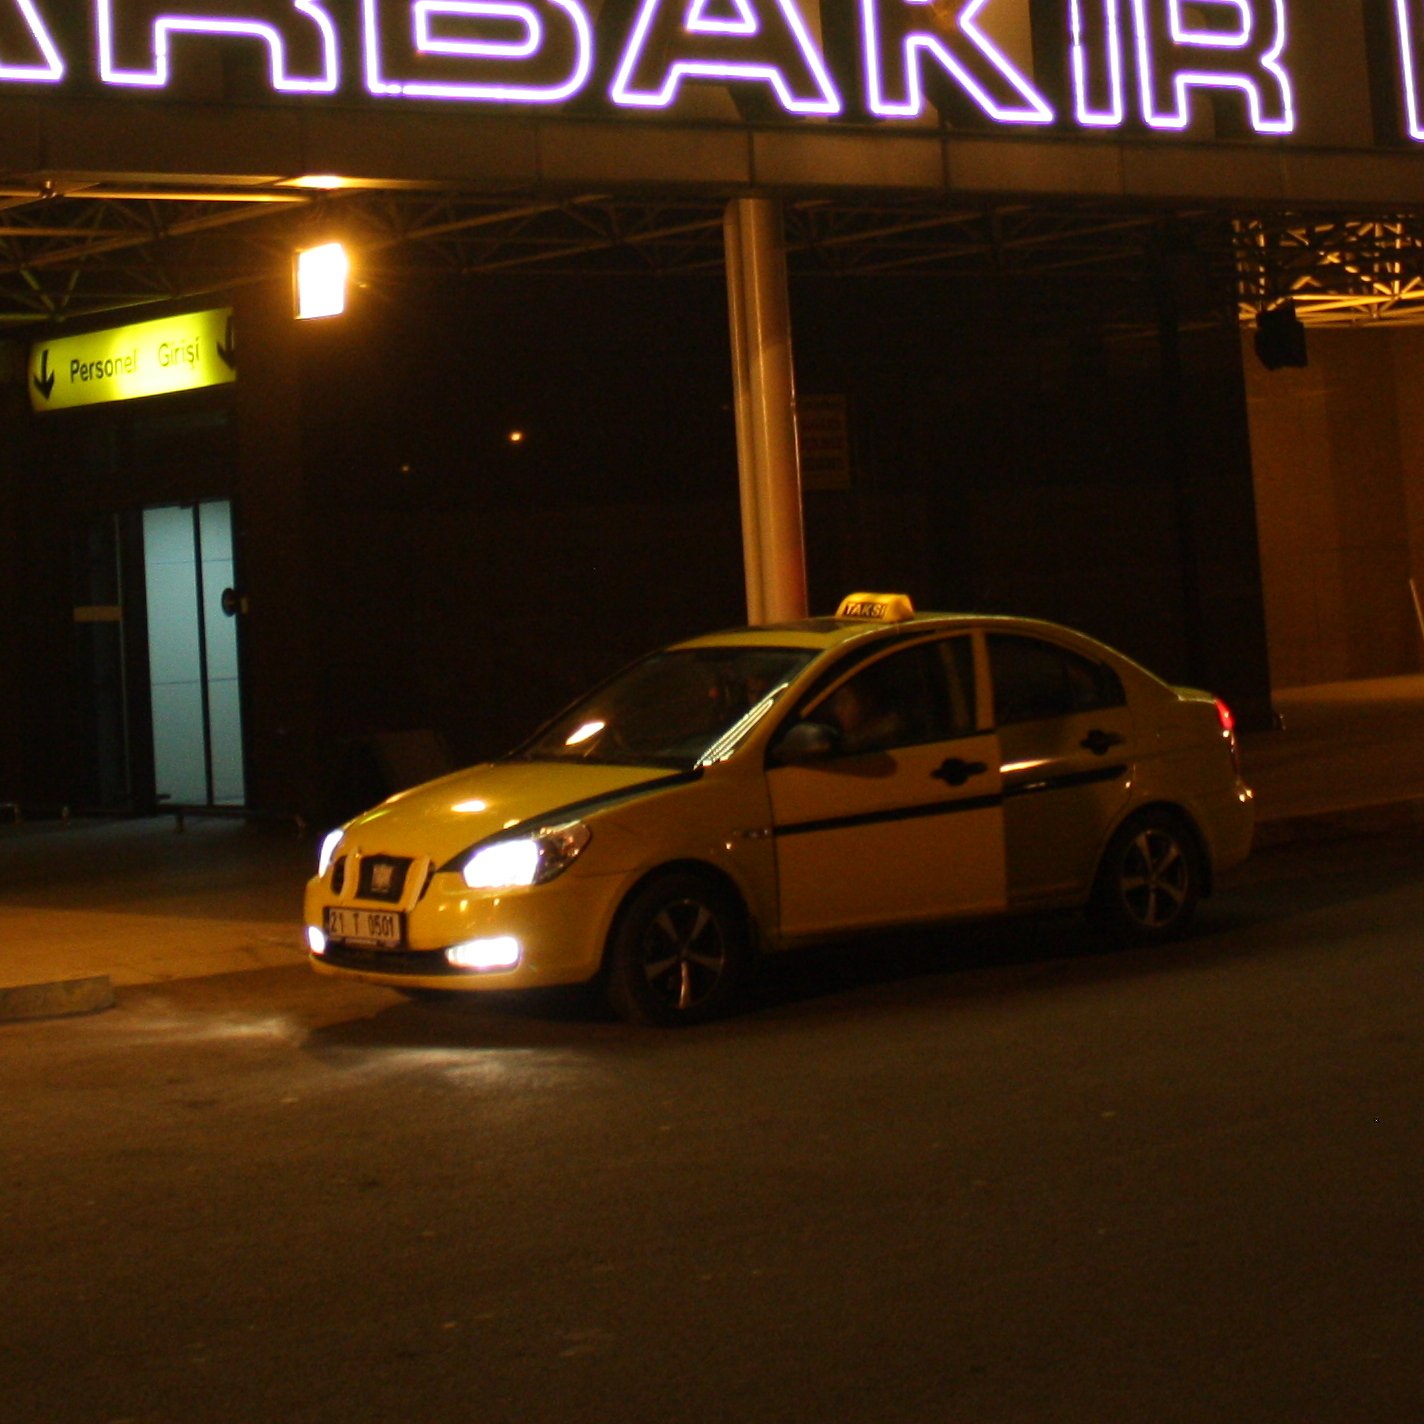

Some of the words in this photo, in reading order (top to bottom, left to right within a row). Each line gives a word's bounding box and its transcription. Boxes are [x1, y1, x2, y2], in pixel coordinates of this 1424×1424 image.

[70, 348, 137, 383] Personel
[330, 911, 344, 933] 21
[353, 912, 359, 935] T
